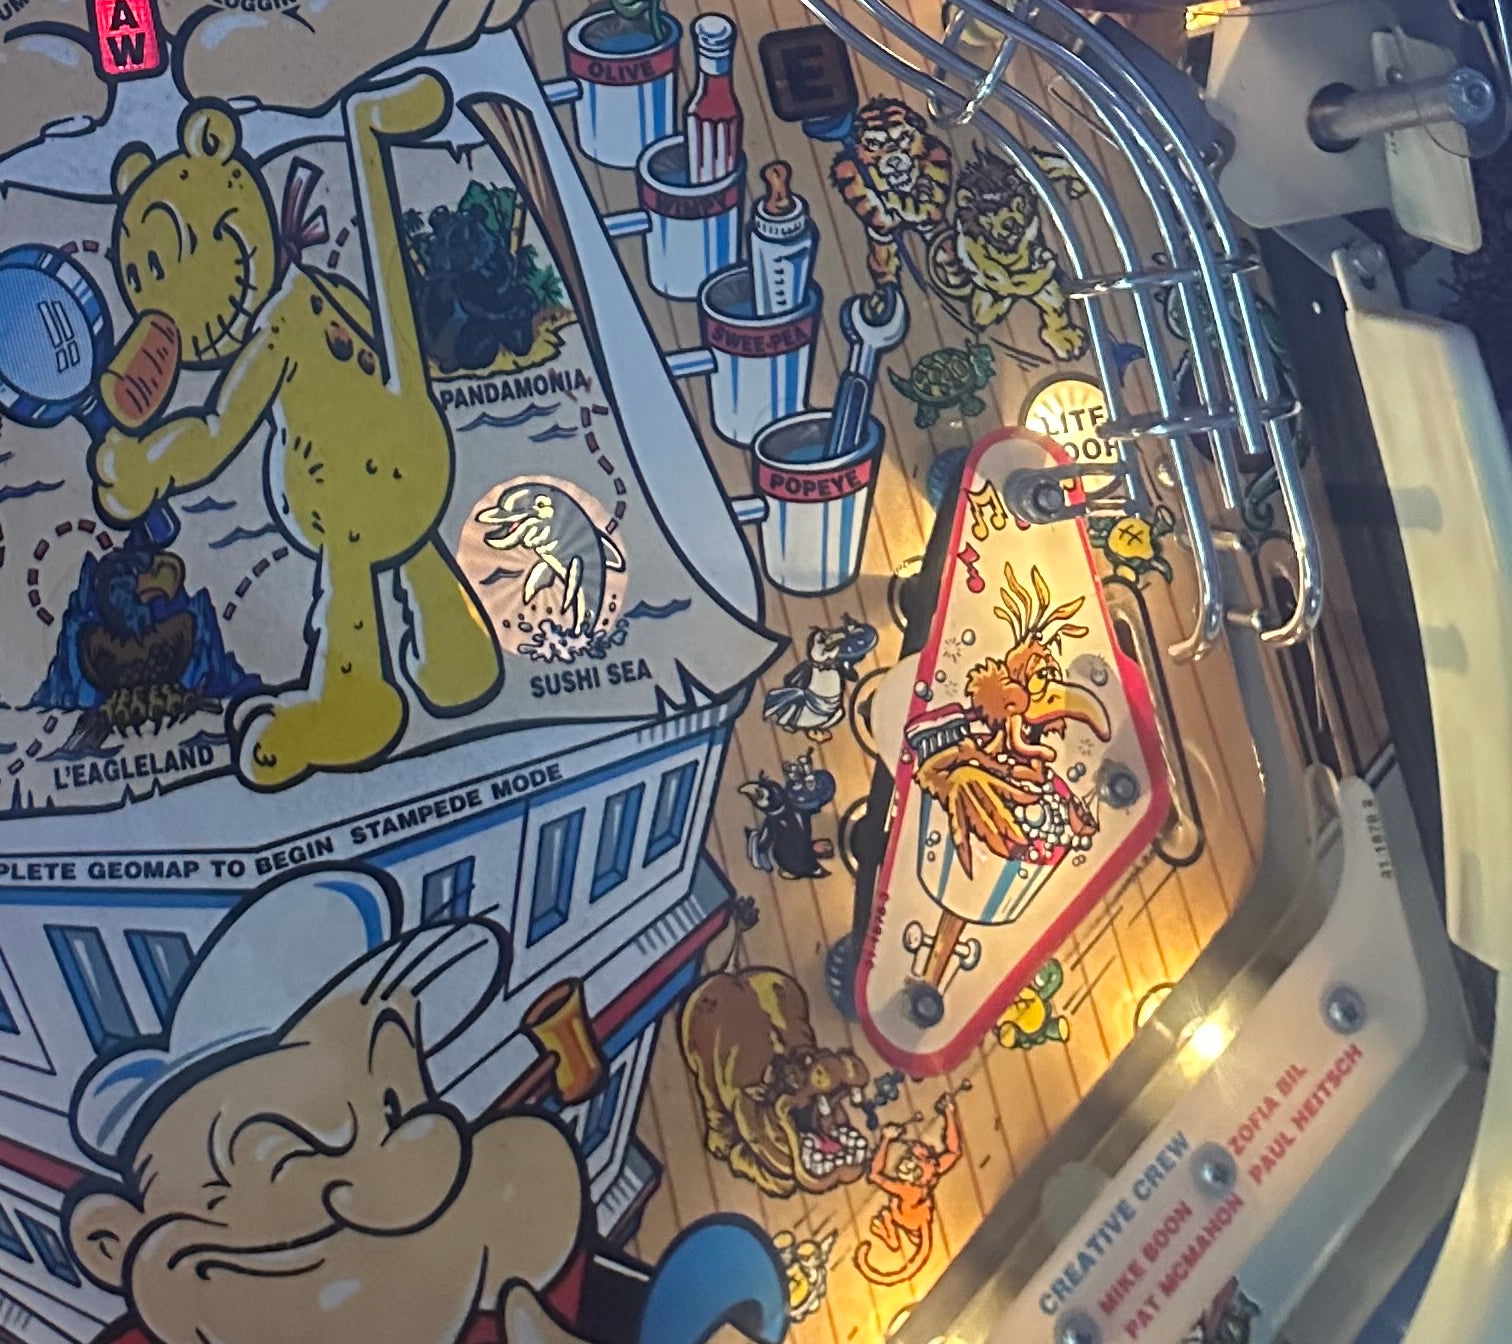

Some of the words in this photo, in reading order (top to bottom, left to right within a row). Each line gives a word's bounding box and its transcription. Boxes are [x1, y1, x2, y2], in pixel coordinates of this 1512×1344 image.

[587, 57, 655, 85] OLIVE
[711, 319, 810, 355] SWEE-PEA
[440, 368, 589, 410] PANDAMONIA
[768, 467, 863, 499] POPEYE
[530, 667, 600, 698] SUSHI
[604, 659, 653, 686] SEA
[53, 743, 215, 792] L'EAGLELAND
[87, 859, 200, 880] GEOMAP
[210, 859, 246, 878] TO
[254, 834, 334, 876] BEGIN
[349, 786, 483, 846] STAMPEDE
[490, 761, 564, 803] MODE
[1226, 1095, 1279, 1157] ZOFIA
[1276, 1062, 1309, 1097] BIL
[1248, 1131, 1295, 1186] PAUL
[1293, 1043, 1365, 1131] HEITSCH
[1038, 1199, 1137, 1316] CREATIVE
[1132, 1130, 1193, 1201] CREW
[1098, 1262, 1144, 1317] MIKE
[1142, 1200, 1194, 1265] BOON
[1124, 1302, 1157, 1341] PAT
[1157, 1192, 1246, 1301] MCMAHON
